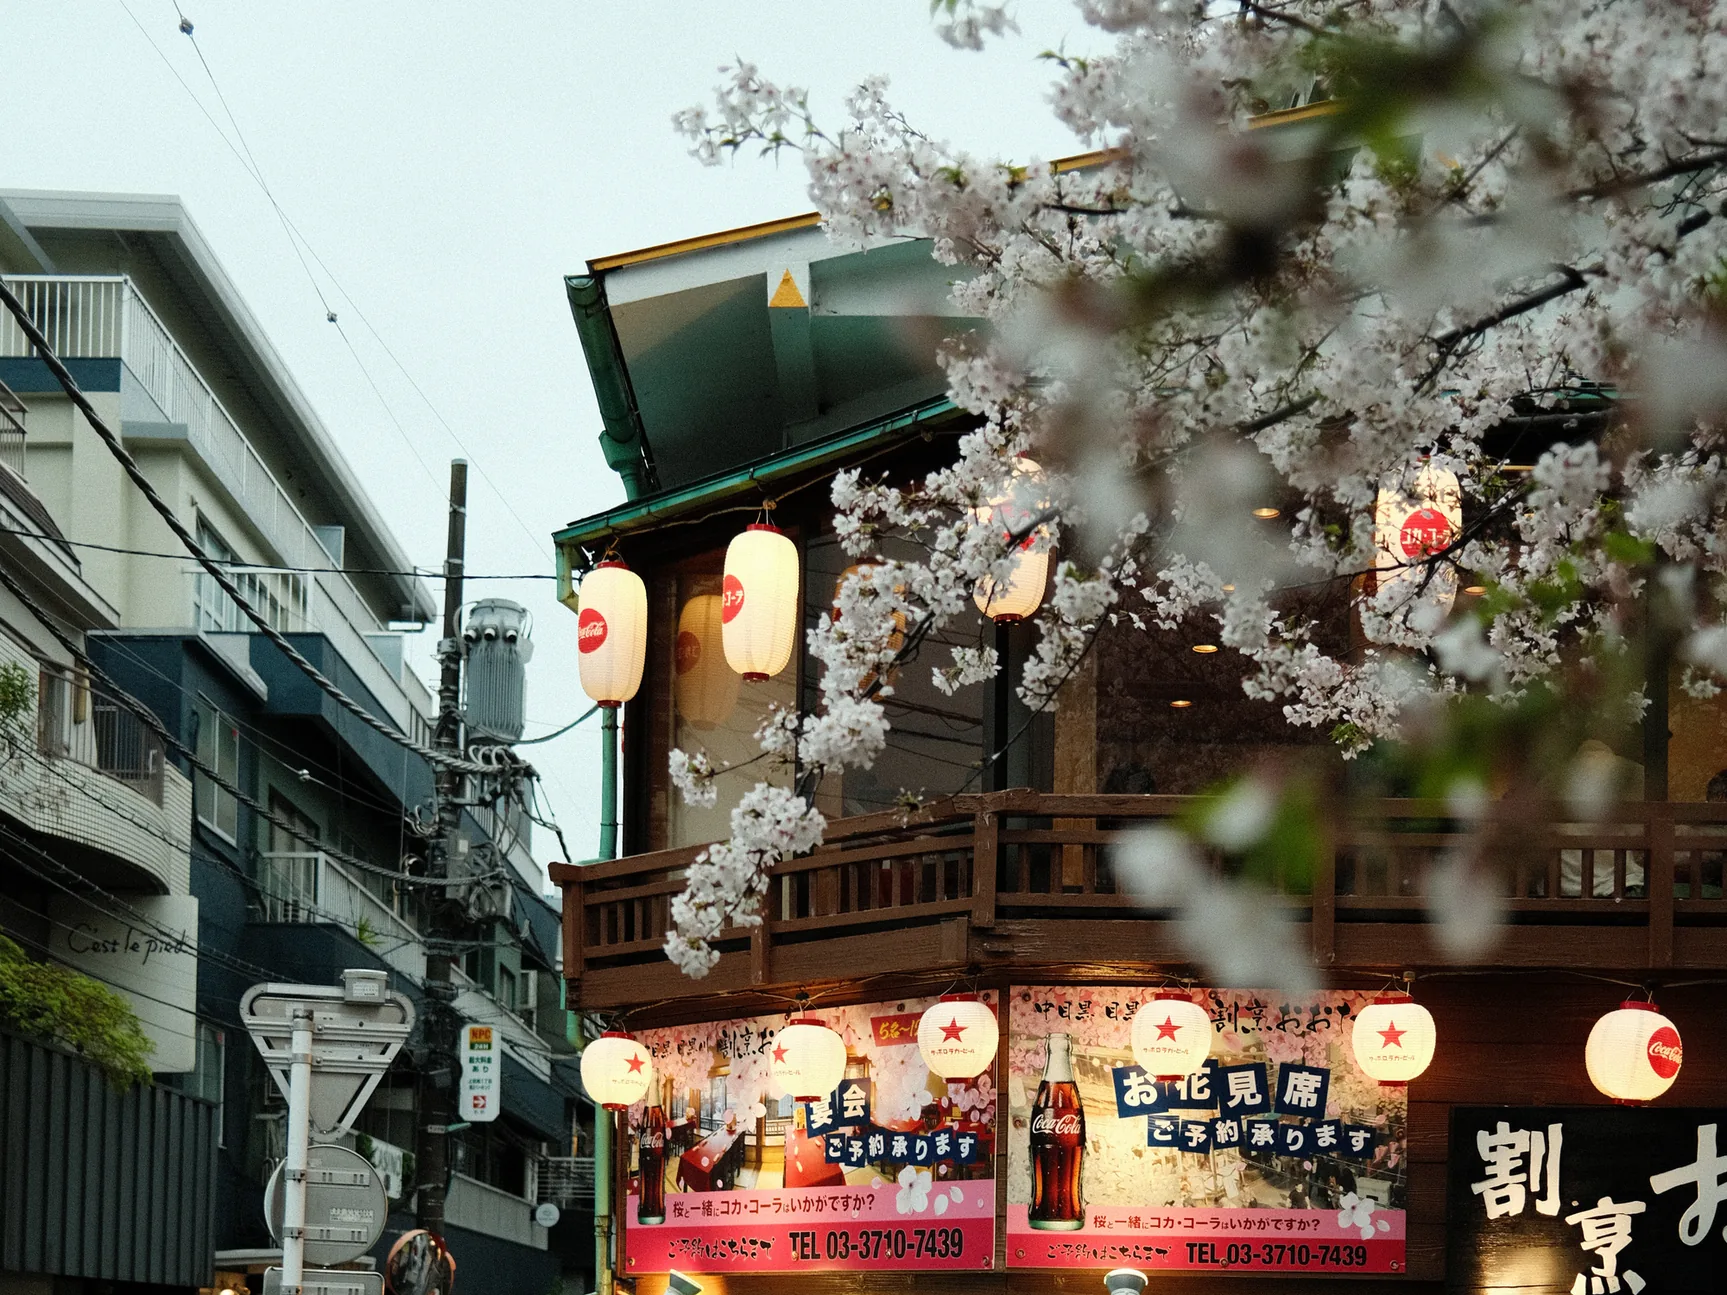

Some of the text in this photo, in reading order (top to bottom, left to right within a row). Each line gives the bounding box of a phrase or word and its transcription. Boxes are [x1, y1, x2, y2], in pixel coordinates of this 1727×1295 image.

[1034, 999, 1095, 1021] 中目黒
[1121, 1068, 1323, 1109] お花見席
[1032, 1113, 1082, 1135] Coca-Cola
[1152, 1120, 1373, 1154] ご予約承ります
[828, 1131, 976, 1162] ご予約承ります
[789, 1230, 821, 1261] TEL
[826, 1227, 964, 1260] 03-3710-7439
[1226, 1243, 1368, 1267] 03-3710-7439
